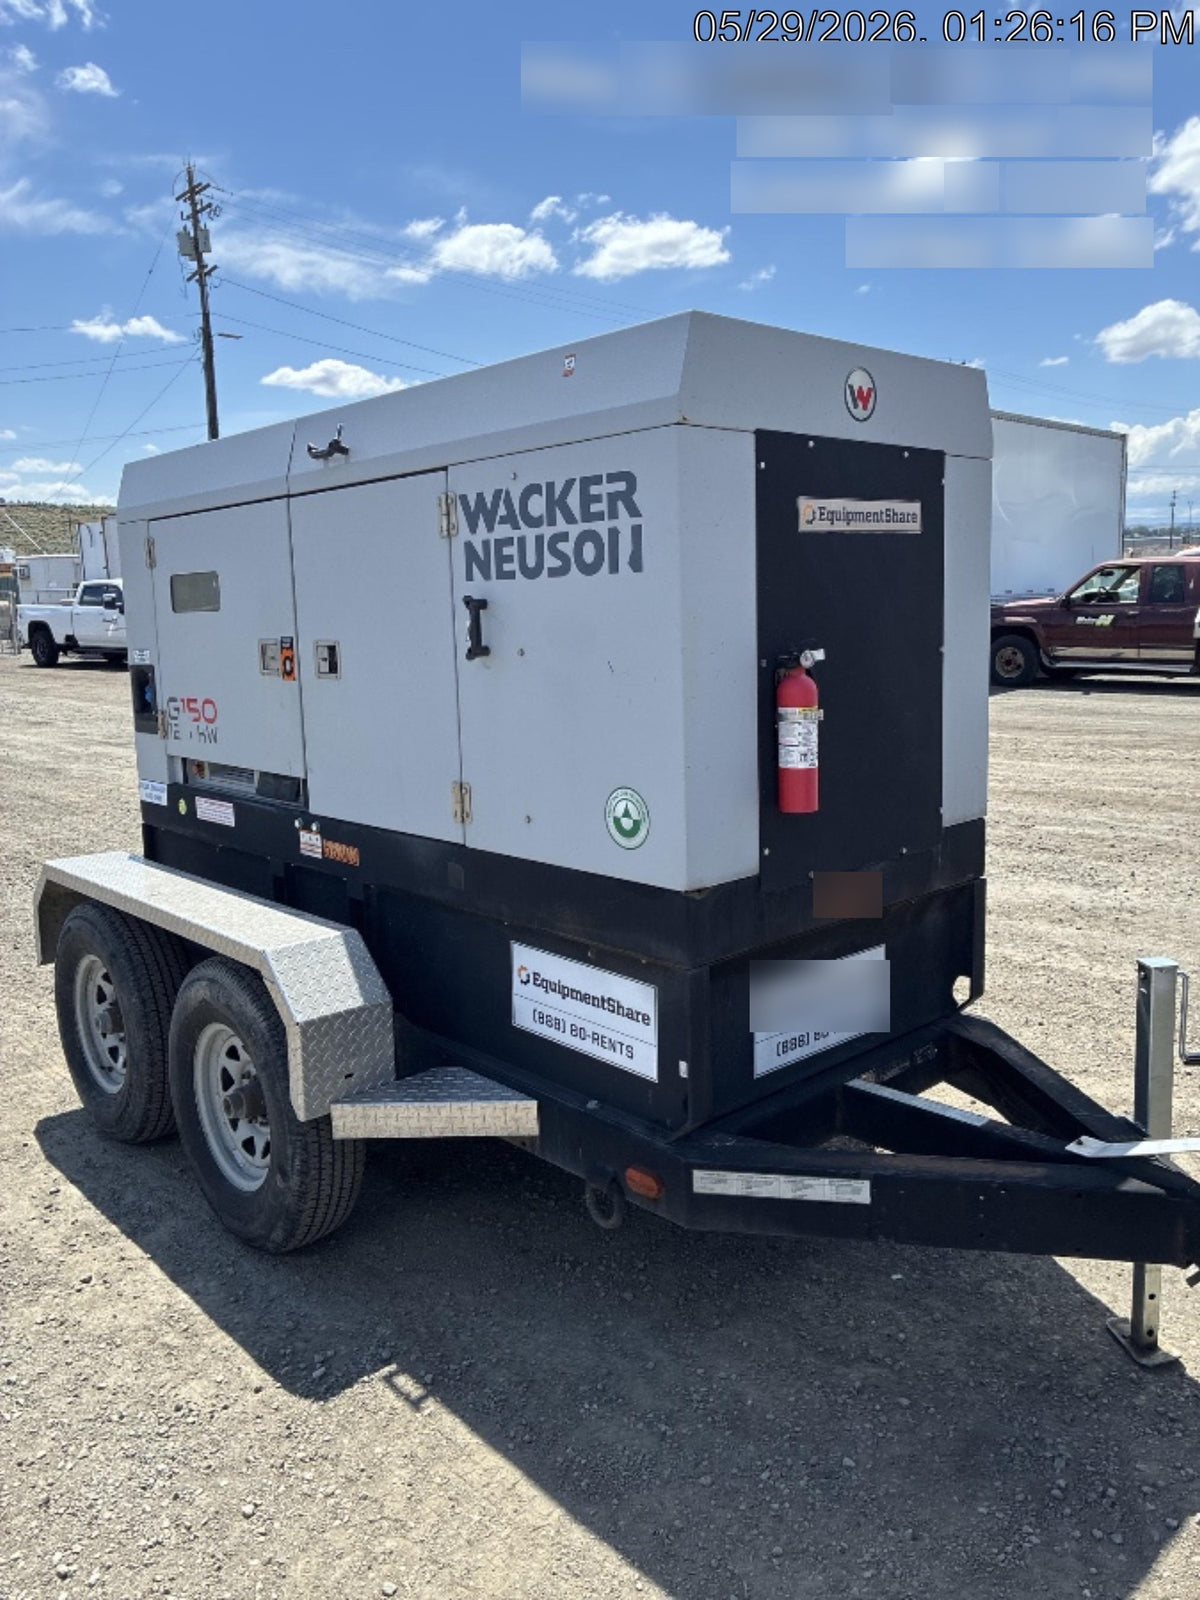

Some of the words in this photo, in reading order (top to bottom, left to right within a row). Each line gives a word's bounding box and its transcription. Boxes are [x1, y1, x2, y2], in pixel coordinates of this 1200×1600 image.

[458, 470, 642, 535] WACKER
[817, 506, 918, 526] EquipmentShare
[464, 524, 643, 582] NEUSON
[167, 696, 218, 724] G150
[532, 971, 651, 1027] EquipmentShare
[532, 1008, 566, 1034] (888)
[569, 1023, 634, 1060] 80-RENTS
[776, 1032, 810, 1057] (888)
